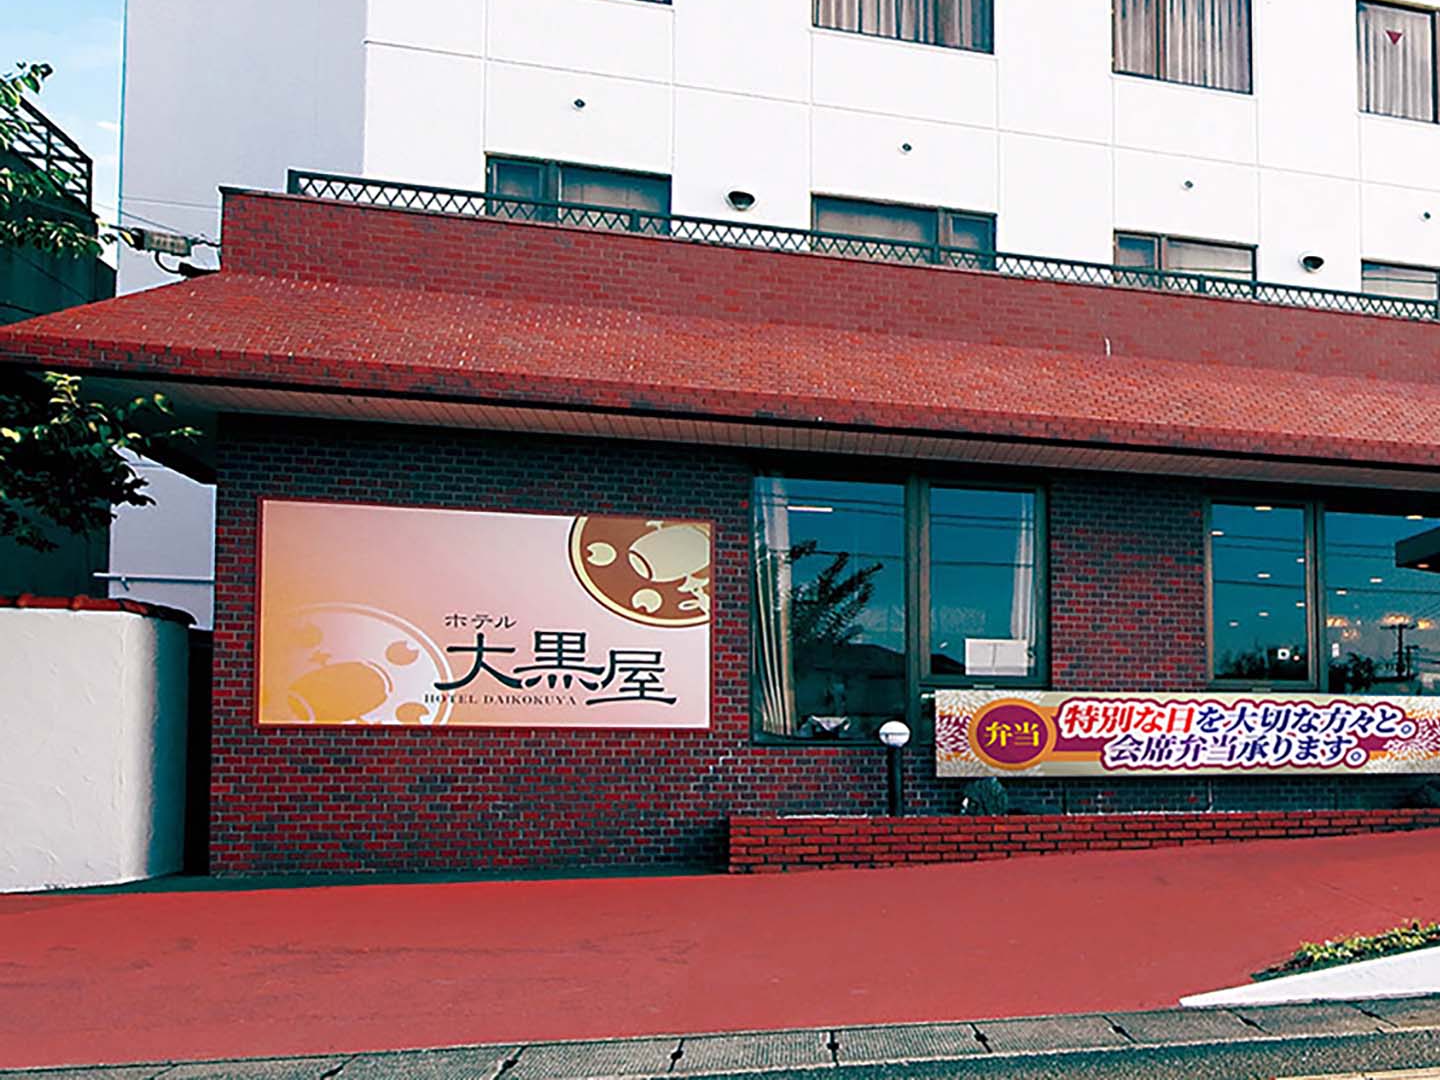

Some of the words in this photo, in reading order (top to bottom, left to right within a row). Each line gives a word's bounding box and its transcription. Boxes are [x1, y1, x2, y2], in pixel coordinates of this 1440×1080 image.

[445, 614, 517, 629] ホテル
[434, 630, 678, 706] 大黒屋
[424, 693, 478, 705] HOTEL
[483, 693, 578, 706] DAIKOKUYA
[984, 721, 1040, 748] 弁当
[1064, 704, 1413, 736] 特別な日を大切な方々と。
[1109, 733, 1363, 764] 会席弁当承ります。
